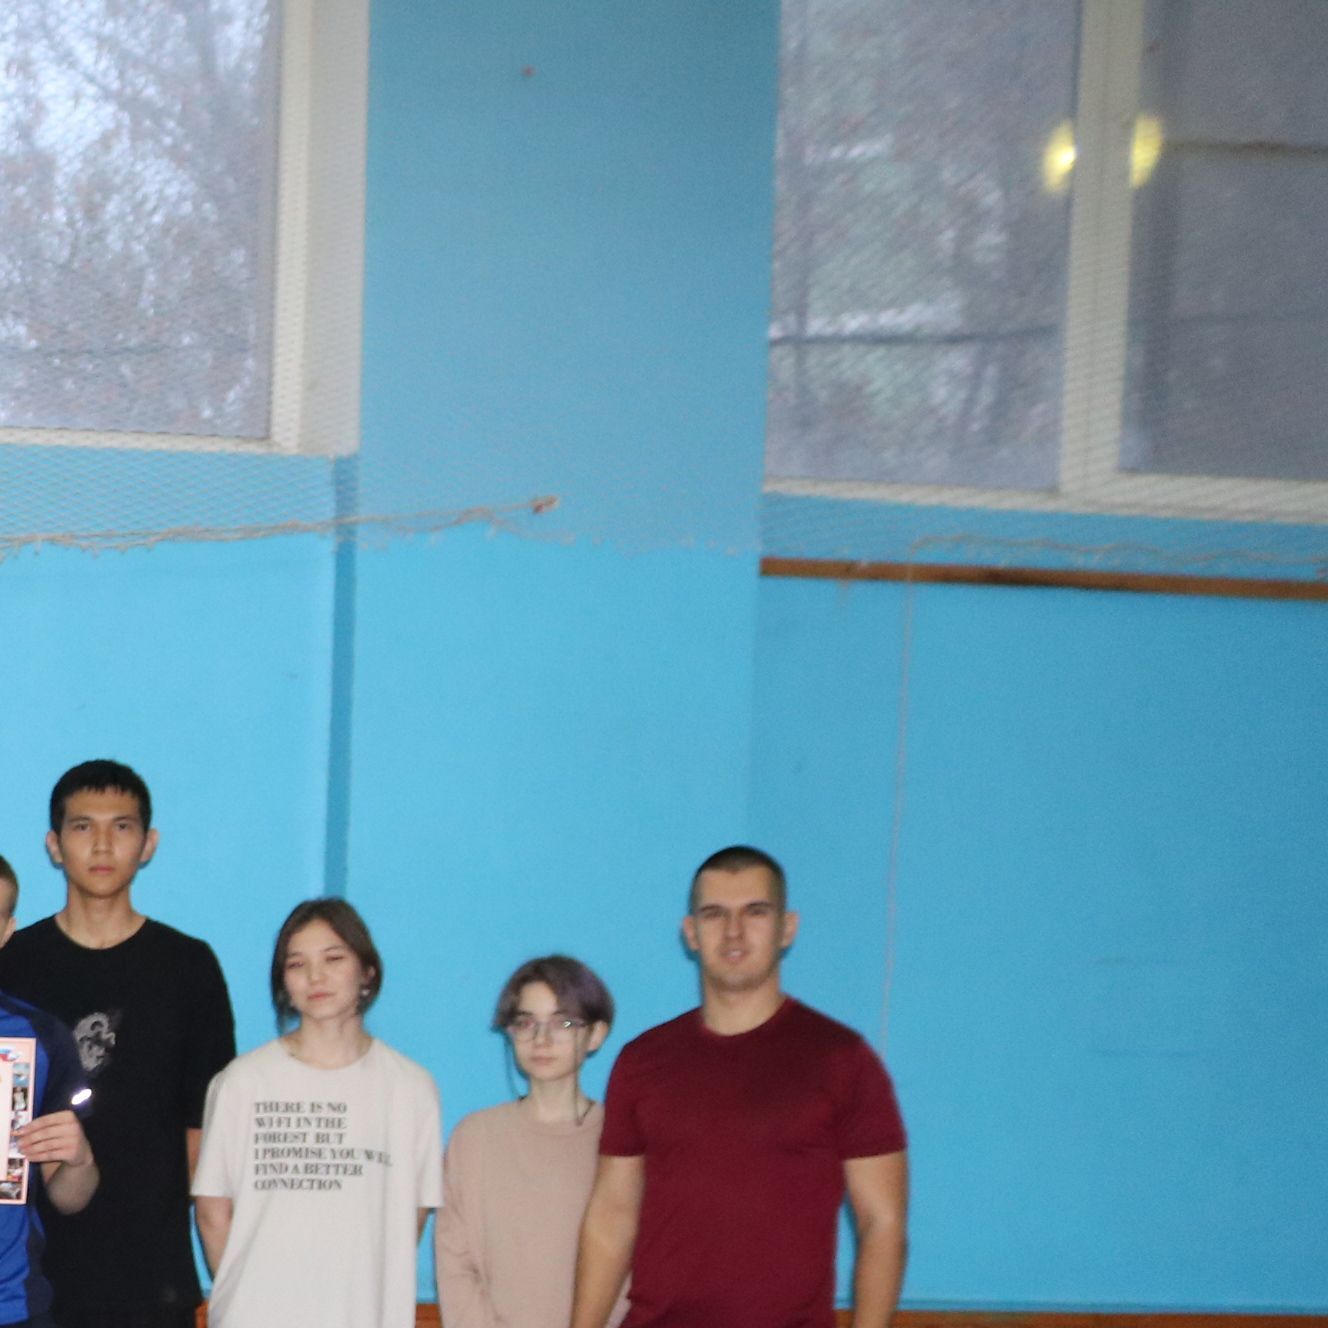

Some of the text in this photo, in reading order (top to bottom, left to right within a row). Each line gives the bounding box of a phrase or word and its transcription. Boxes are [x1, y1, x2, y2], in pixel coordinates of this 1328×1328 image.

[254, 1102, 347, 1113] THERE IS NO
[315, 1117, 347, 1129] THE
[254, 1132, 307, 1144] FOREST
[263, 1147, 327, 1159] PROMISE
[330, 1148, 356, 1160] YOU
[254, 1163, 363, 1176] FIND A BETTER
[254, 1179, 342, 1190] CONNECTION
